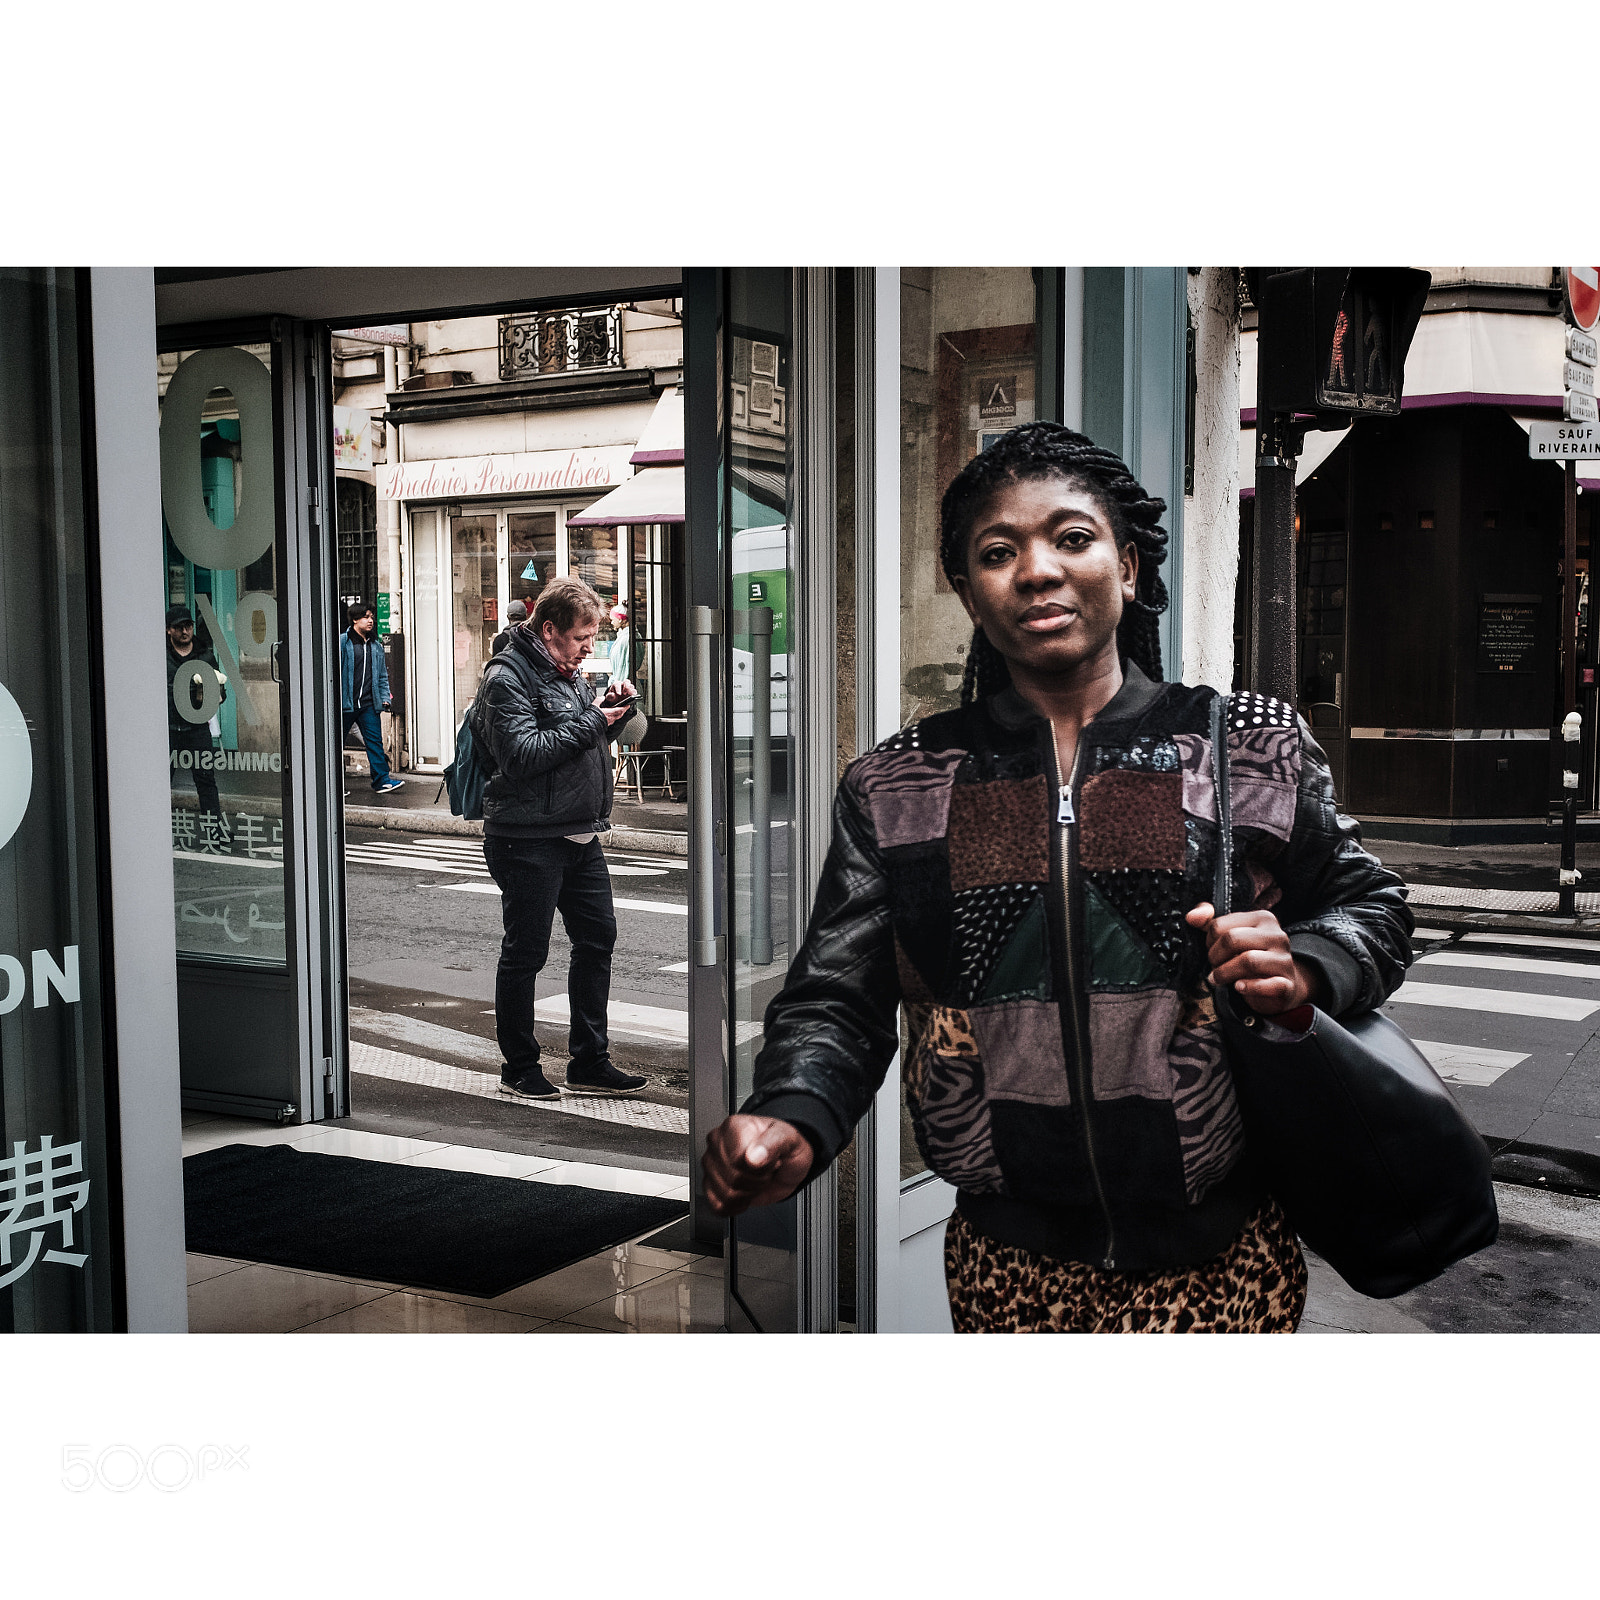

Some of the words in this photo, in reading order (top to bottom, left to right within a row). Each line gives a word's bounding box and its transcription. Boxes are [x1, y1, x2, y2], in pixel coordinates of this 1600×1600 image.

[1557, 429, 1593, 441] SAUF
[386, 463, 469, 499] Broderies
[473, 452, 611, 494] Personnalisées
